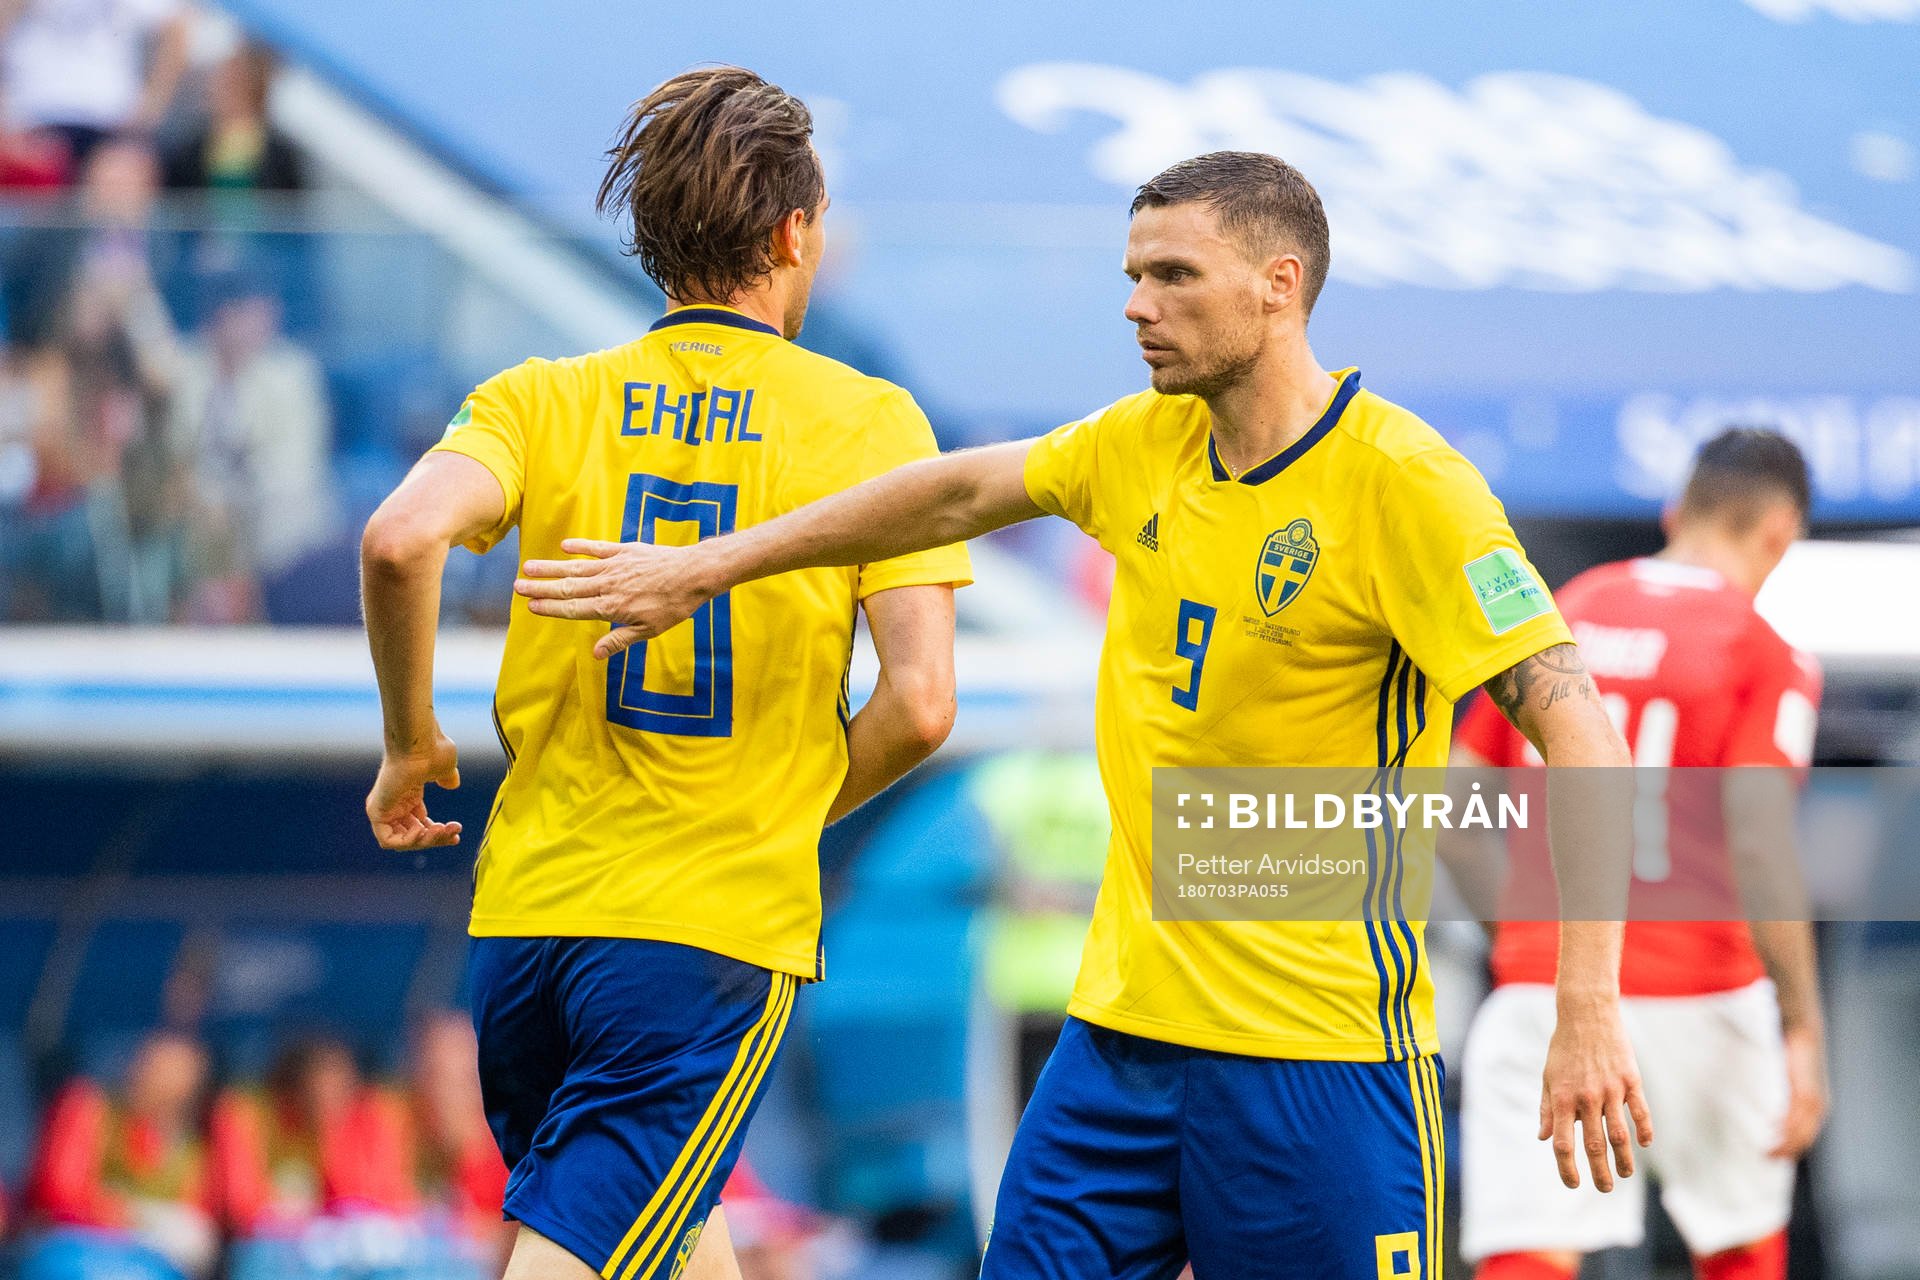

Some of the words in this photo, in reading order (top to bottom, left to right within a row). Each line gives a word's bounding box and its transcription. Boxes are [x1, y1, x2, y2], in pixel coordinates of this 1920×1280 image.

[1137, 532, 1159, 552] adidas
[1273, 543, 1309, 559] SVERIGE
[1171, 598, 1218, 712] 9
